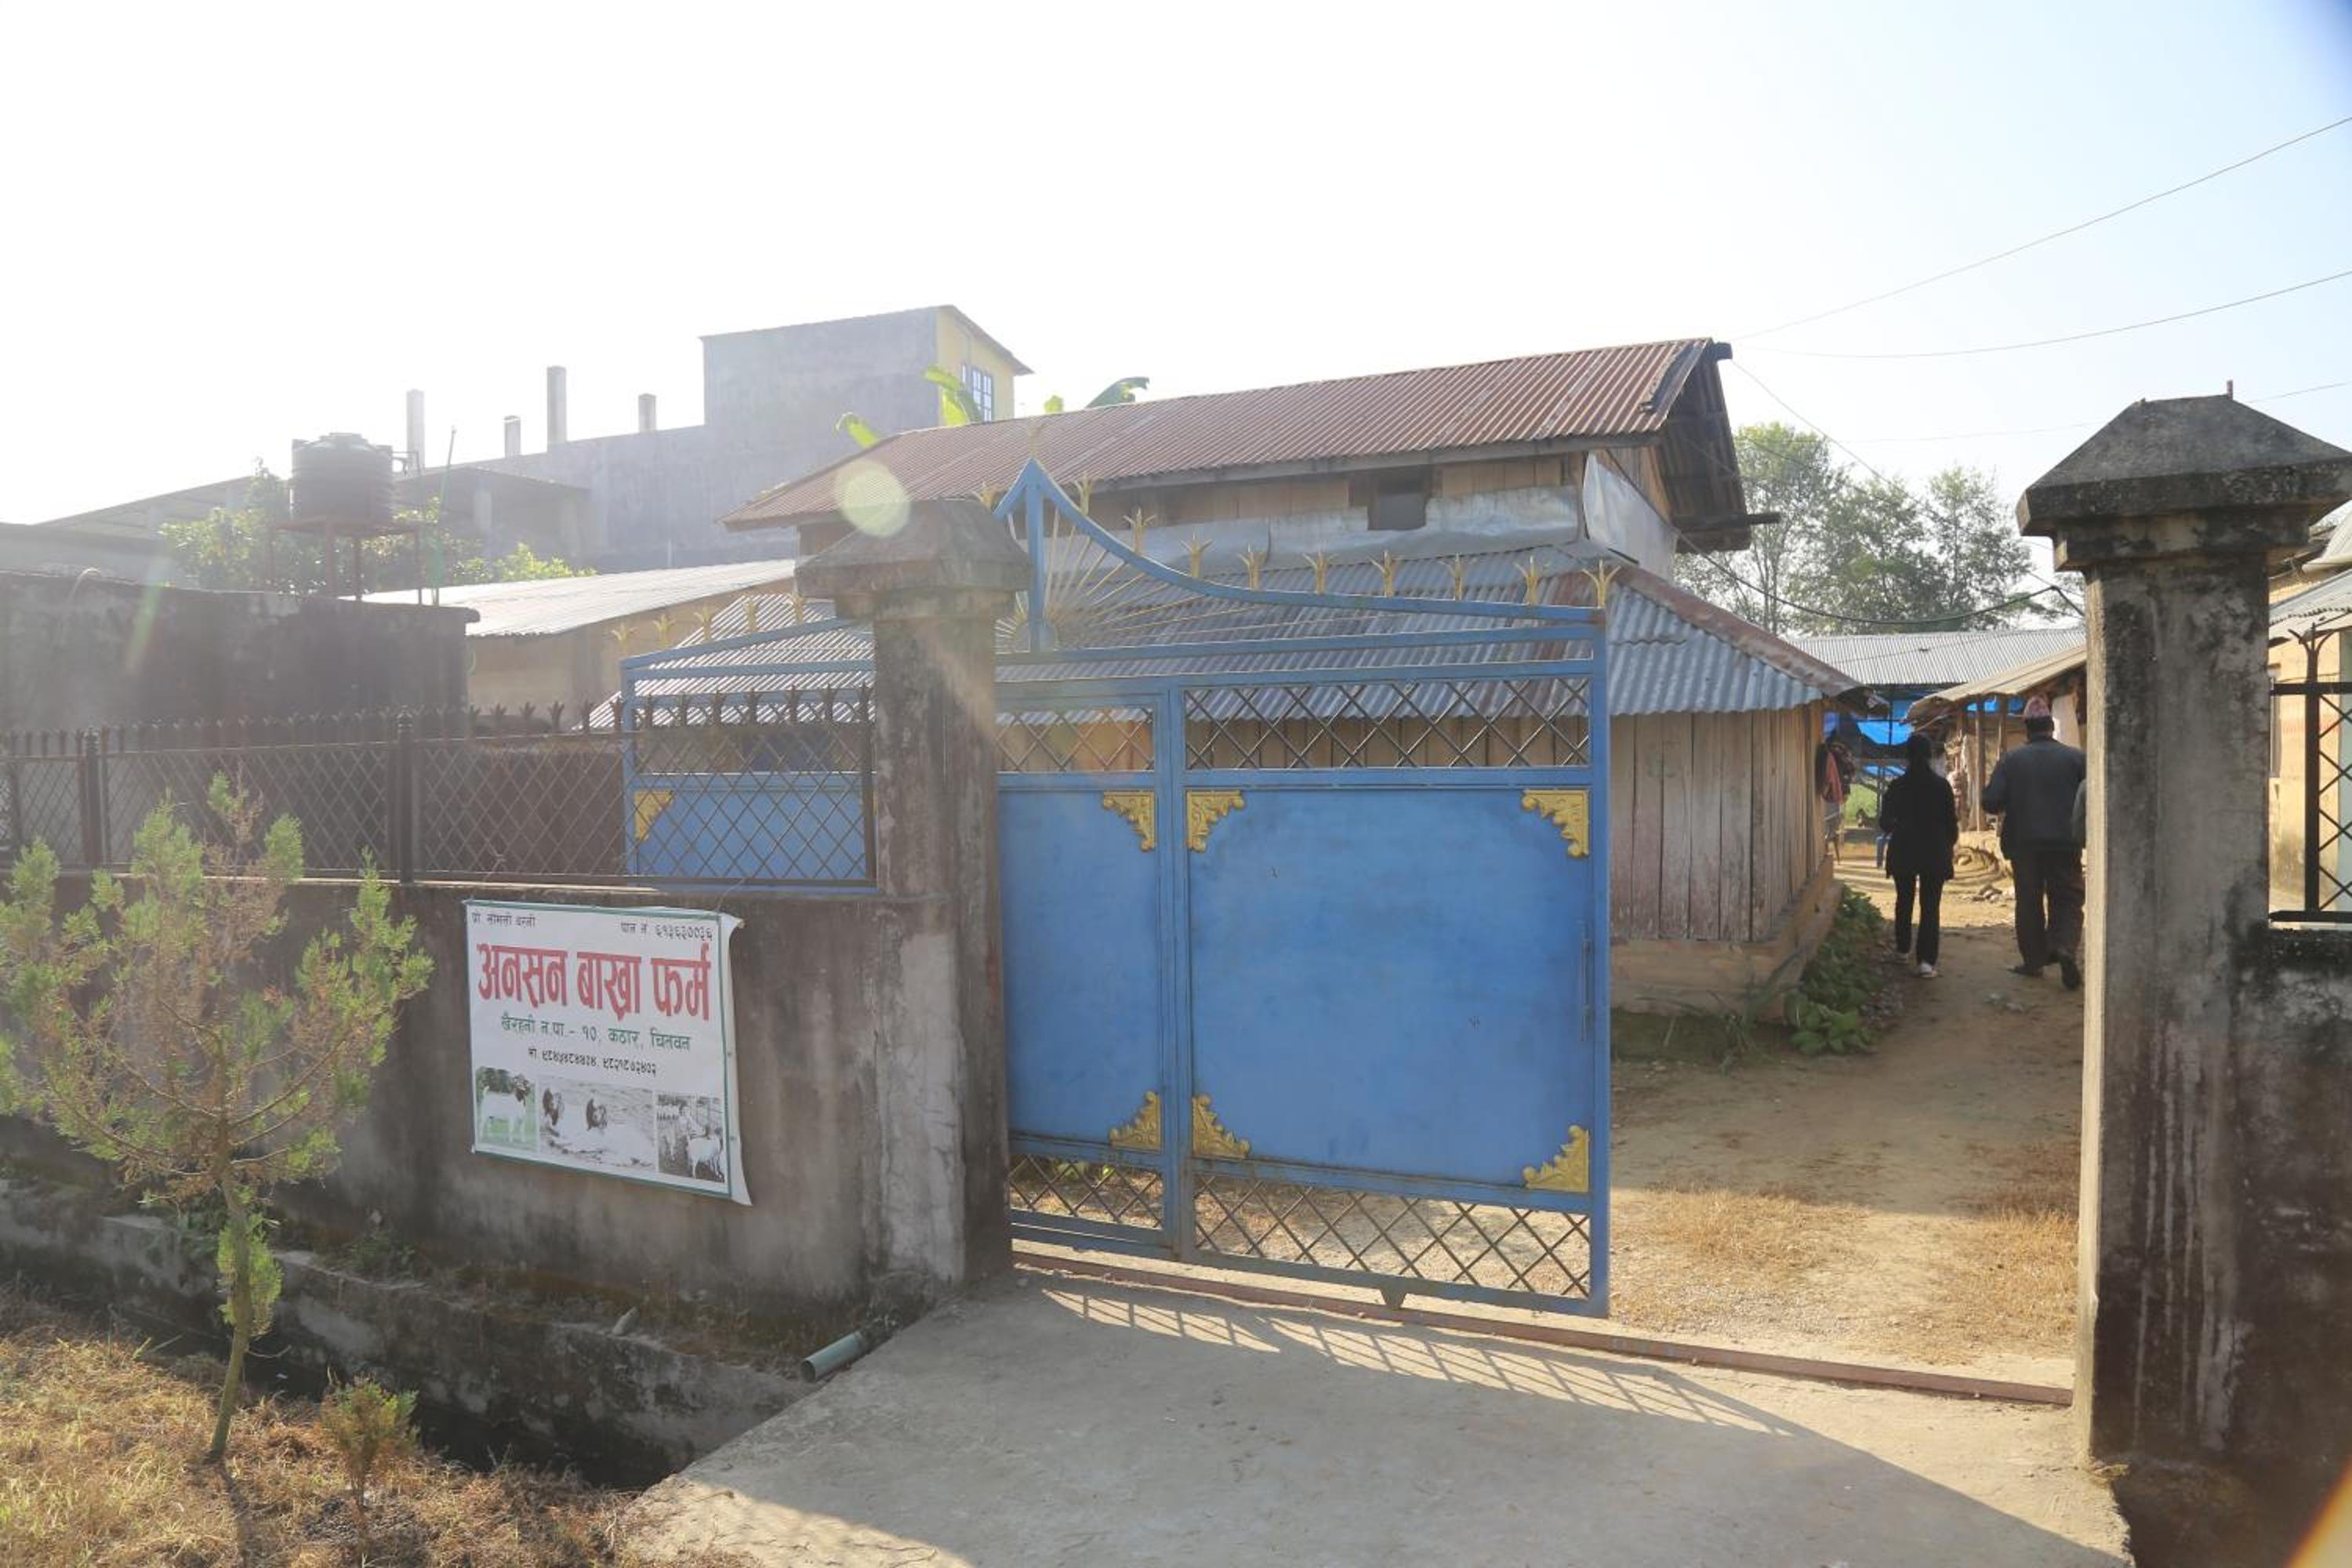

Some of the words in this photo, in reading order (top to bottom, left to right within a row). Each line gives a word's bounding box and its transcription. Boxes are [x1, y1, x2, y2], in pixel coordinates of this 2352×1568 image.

[476, 943, 568, 1008] अनसन
[576, 951, 641, 1022] बाख्रा
[651, 940, 712, 1021] फर्म
[650, 1025, 691, 1051] चितवन
